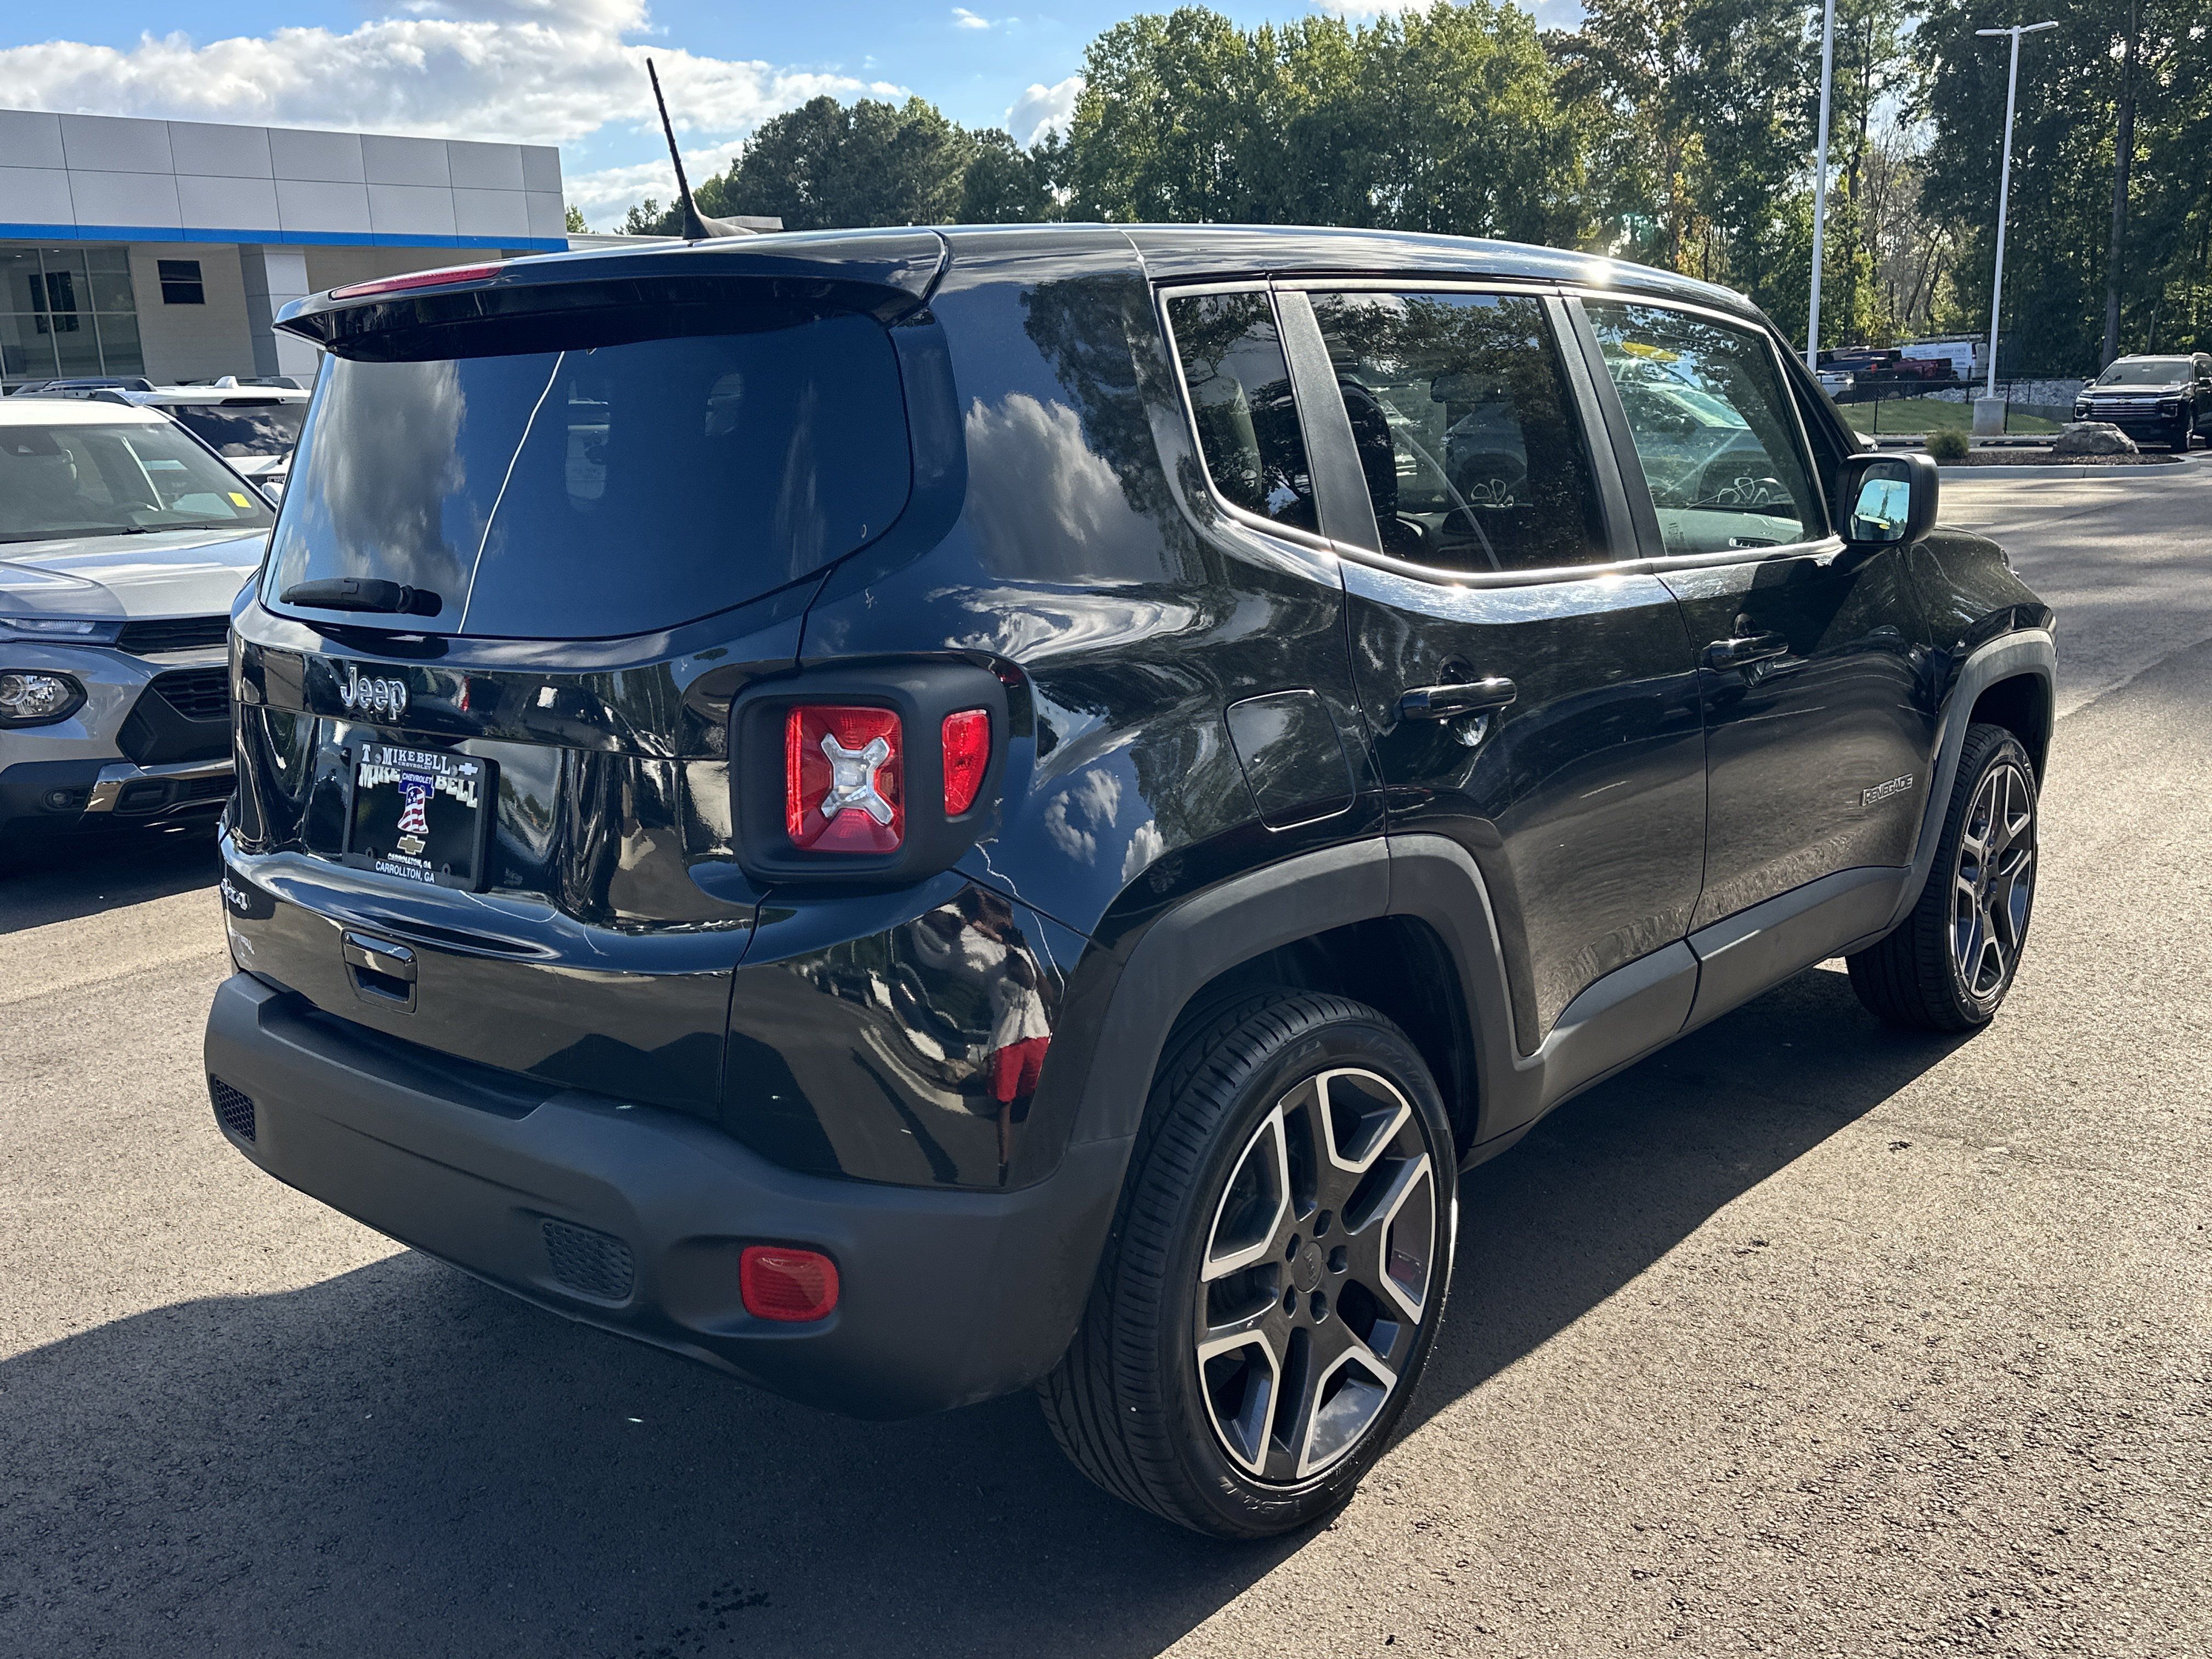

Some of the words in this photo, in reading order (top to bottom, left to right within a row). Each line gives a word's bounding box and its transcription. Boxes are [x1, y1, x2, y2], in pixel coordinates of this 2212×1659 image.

[340, 665, 407, 720] Jeep
[398, 761, 432, 770] CHEVROLET
[402, 772, 433, 785] CHEVROLET
[358, 763, 401, 789] MIKE
[435, 775, 478, 808] BELL
[1861, 773, 1914, 806] RENEGADE
[375, 860, 422, 882] CARROLLTON,
[424, 871, 435, 883] GA
